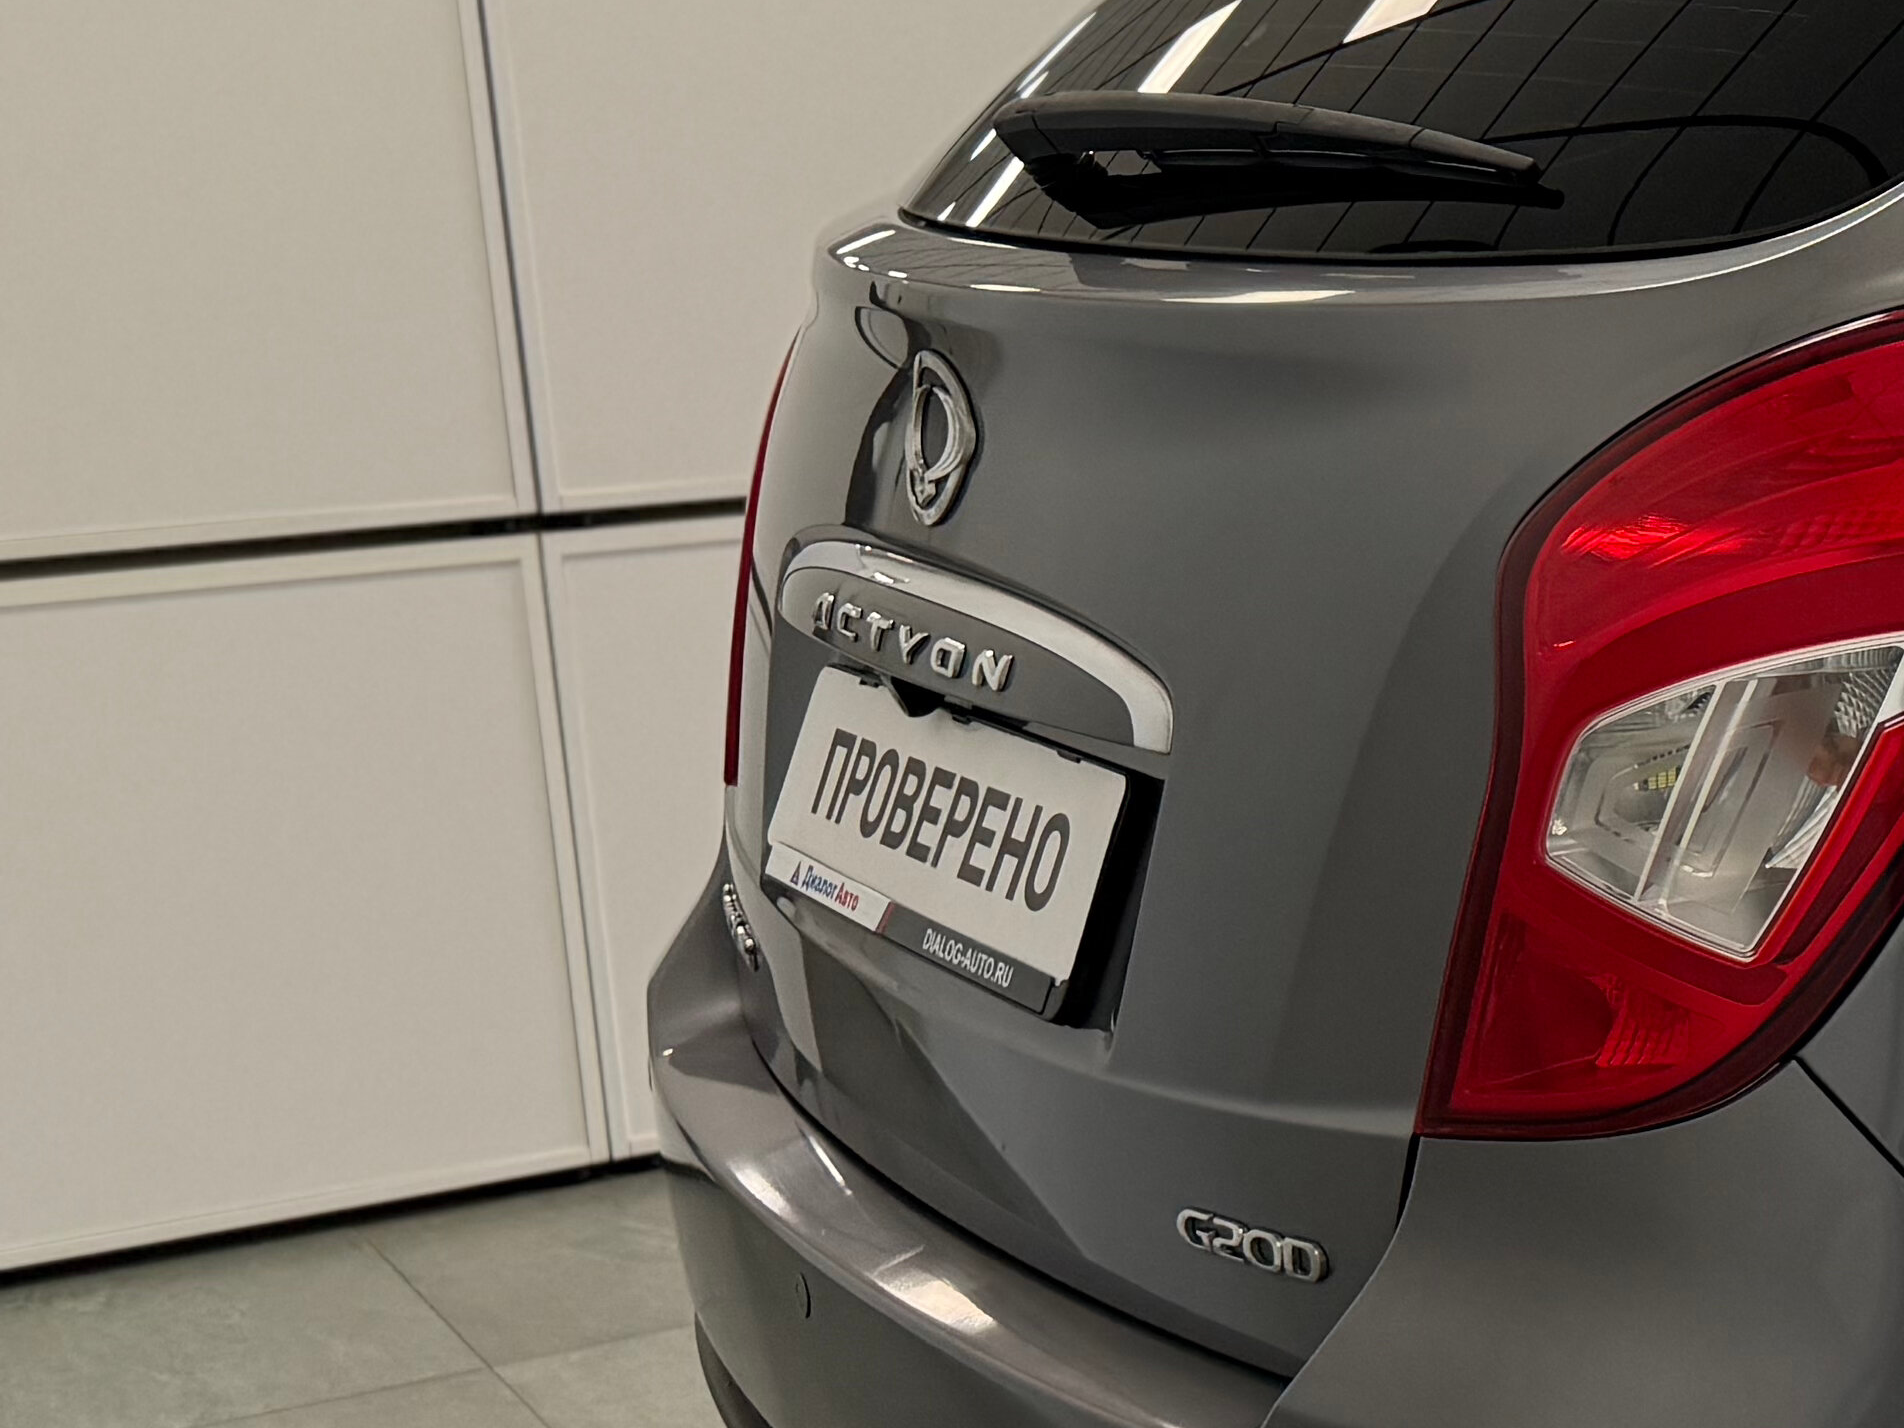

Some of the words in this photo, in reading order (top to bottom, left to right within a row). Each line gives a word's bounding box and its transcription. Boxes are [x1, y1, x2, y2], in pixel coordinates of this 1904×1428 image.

[813, 592, 1014, 692] ACTYON
[810, 728, 1071, 912] ПРОВЕРЕНО
[922, 928, 1015, 988] DIALOG-AUTO.RU
[1176, 1207, 1328, 1284] G20D
